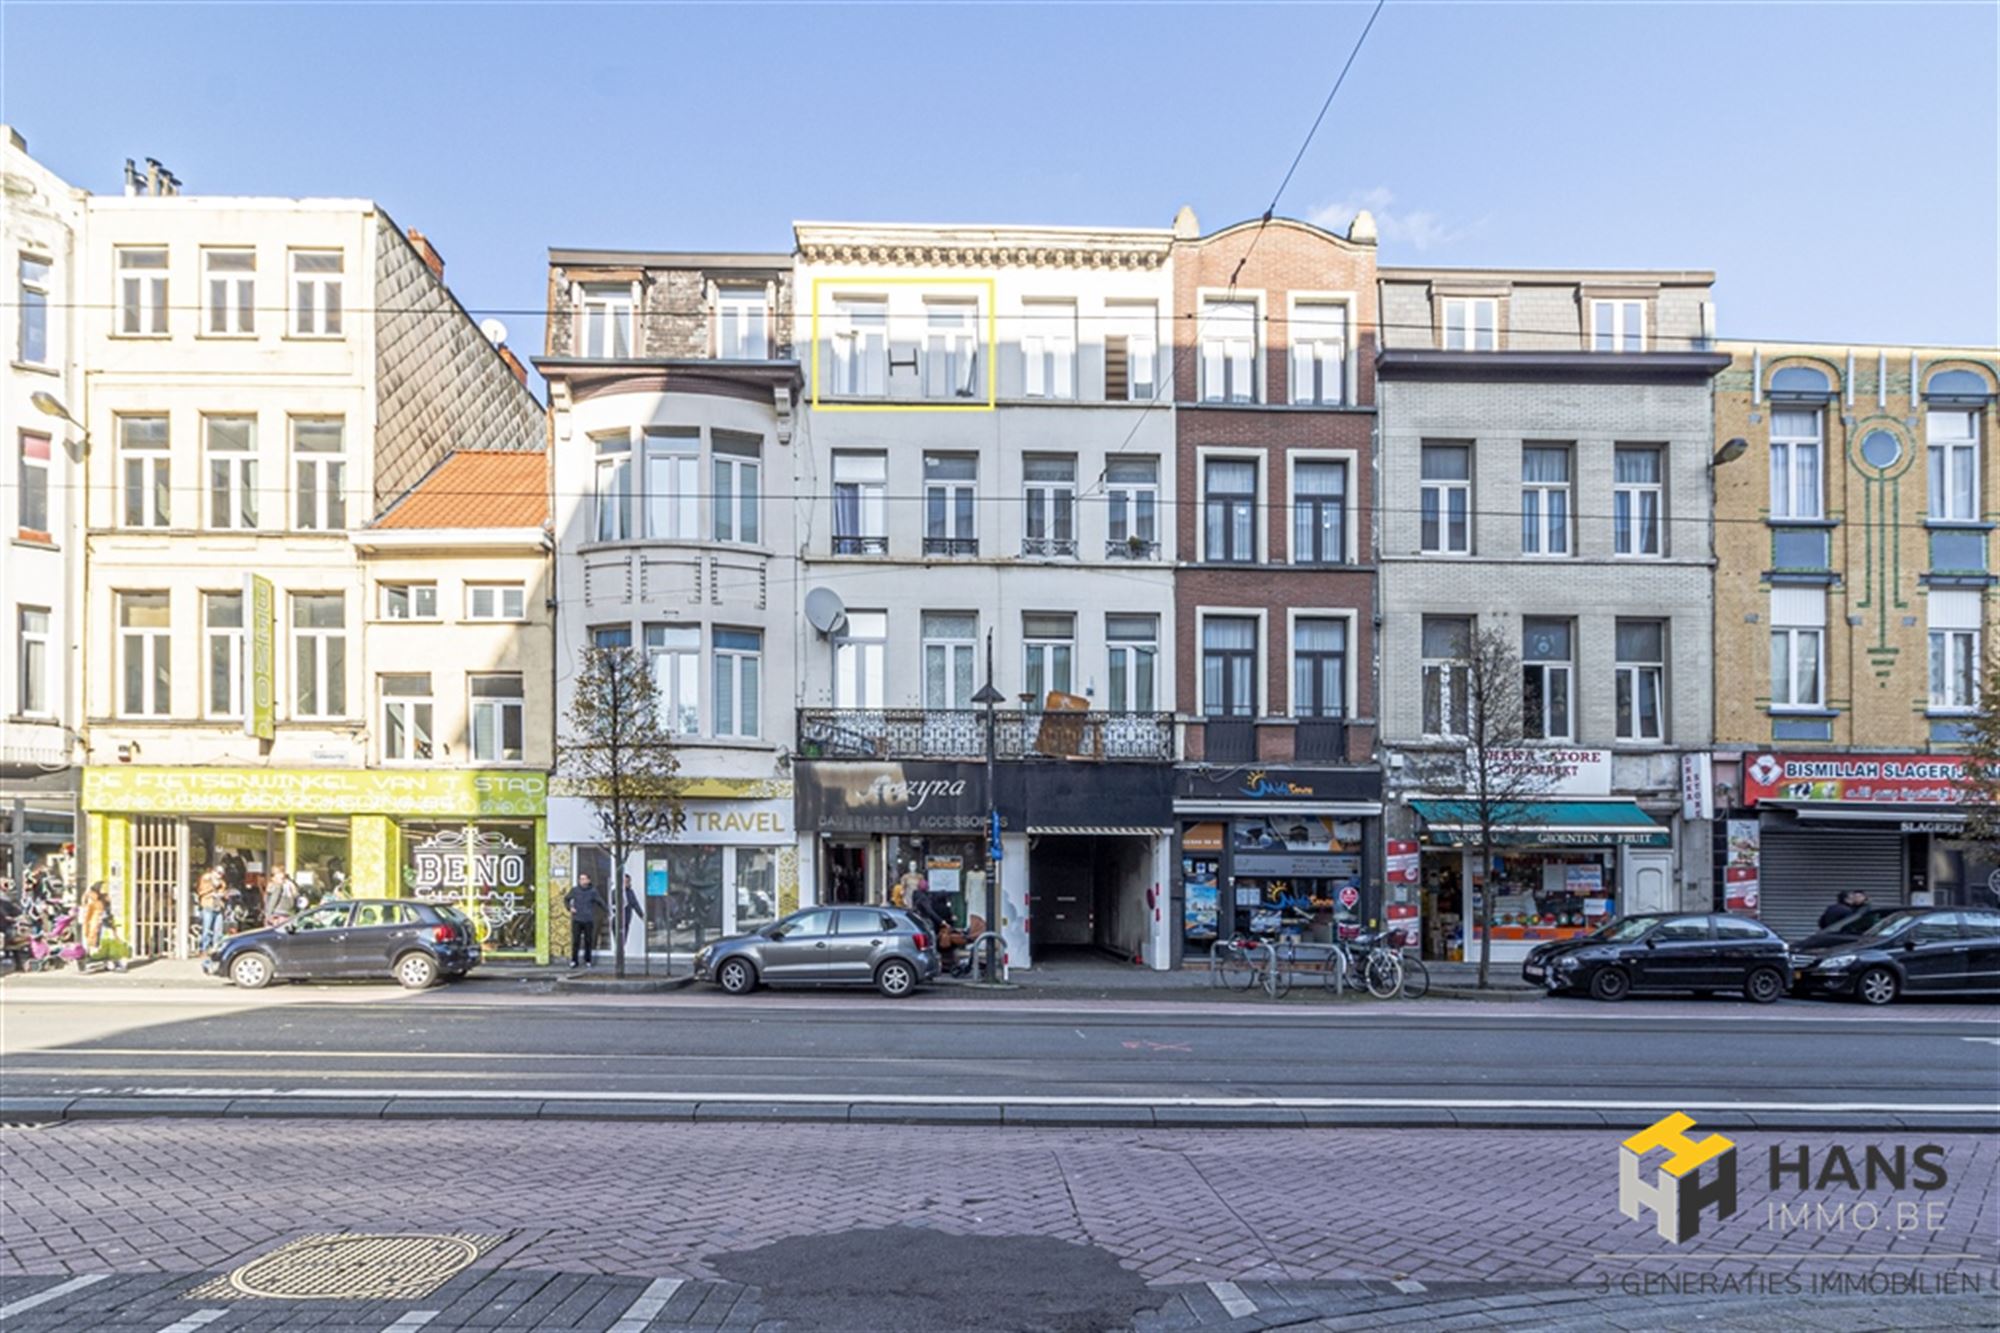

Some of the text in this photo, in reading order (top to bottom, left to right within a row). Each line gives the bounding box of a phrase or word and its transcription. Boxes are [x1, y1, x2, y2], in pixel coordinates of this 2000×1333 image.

[1549, 751, 1601, 763] STORE
[1786, 762, 1878, 778] BISMILLAH
[1884, 763, 1967, 780] SLAGERIJ
[87, 772, 122, 787] DE
[136, 773, 358, 790] FIETSENWINKEL
[371, 775, 426, 790] VAN
[474, 777, 543, 794] STAD
[693, 812, 785, 832] TRAVEL
[1537, 833, 1652, 843] GROENTEN & FRUIT
[416, 855, 525, 887] BENO
